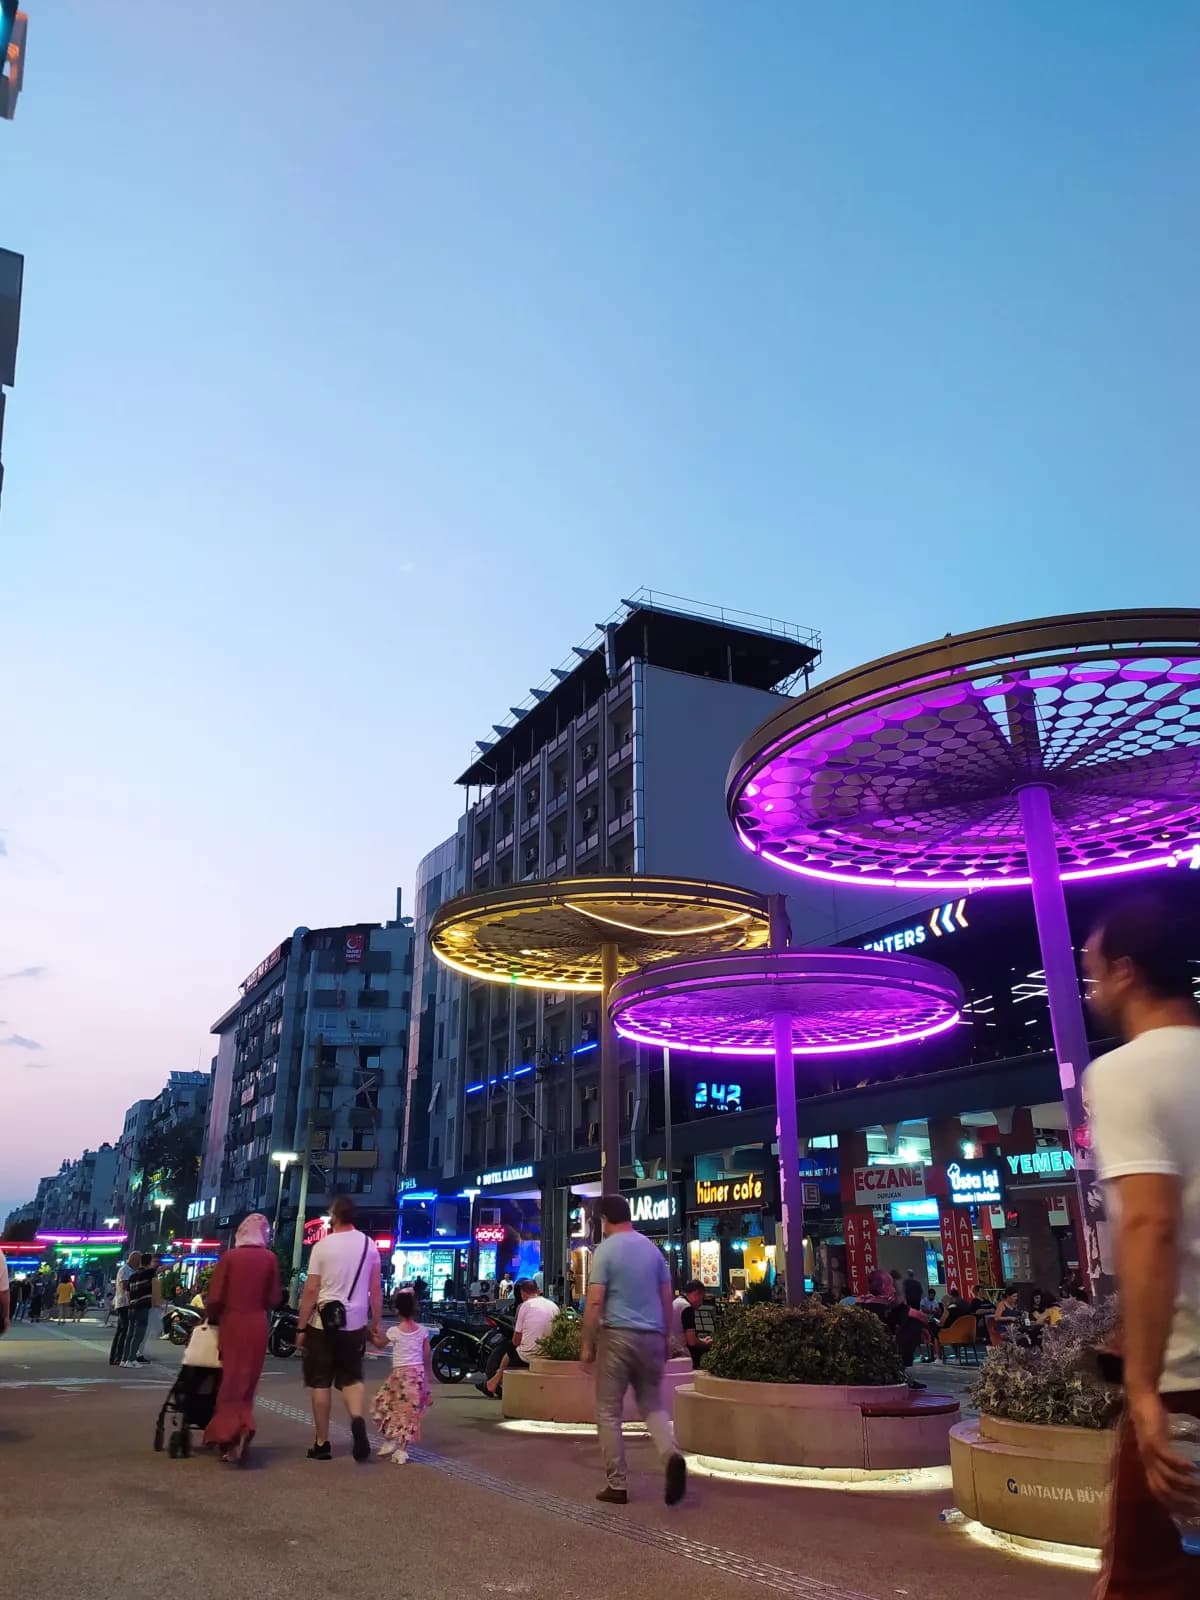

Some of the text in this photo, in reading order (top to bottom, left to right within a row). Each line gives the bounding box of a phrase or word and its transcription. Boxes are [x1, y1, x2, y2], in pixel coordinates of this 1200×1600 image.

[483, 1172, 502, 1186] HOTEL
[806, 1168, 823, 1176] MAKET
[855, 1167, 922, 1191] ECZANE
[697, 1172, 762, 1204] hüner cafe
[1020, 1484, 1106, 1503] ANTALYA BÜY
